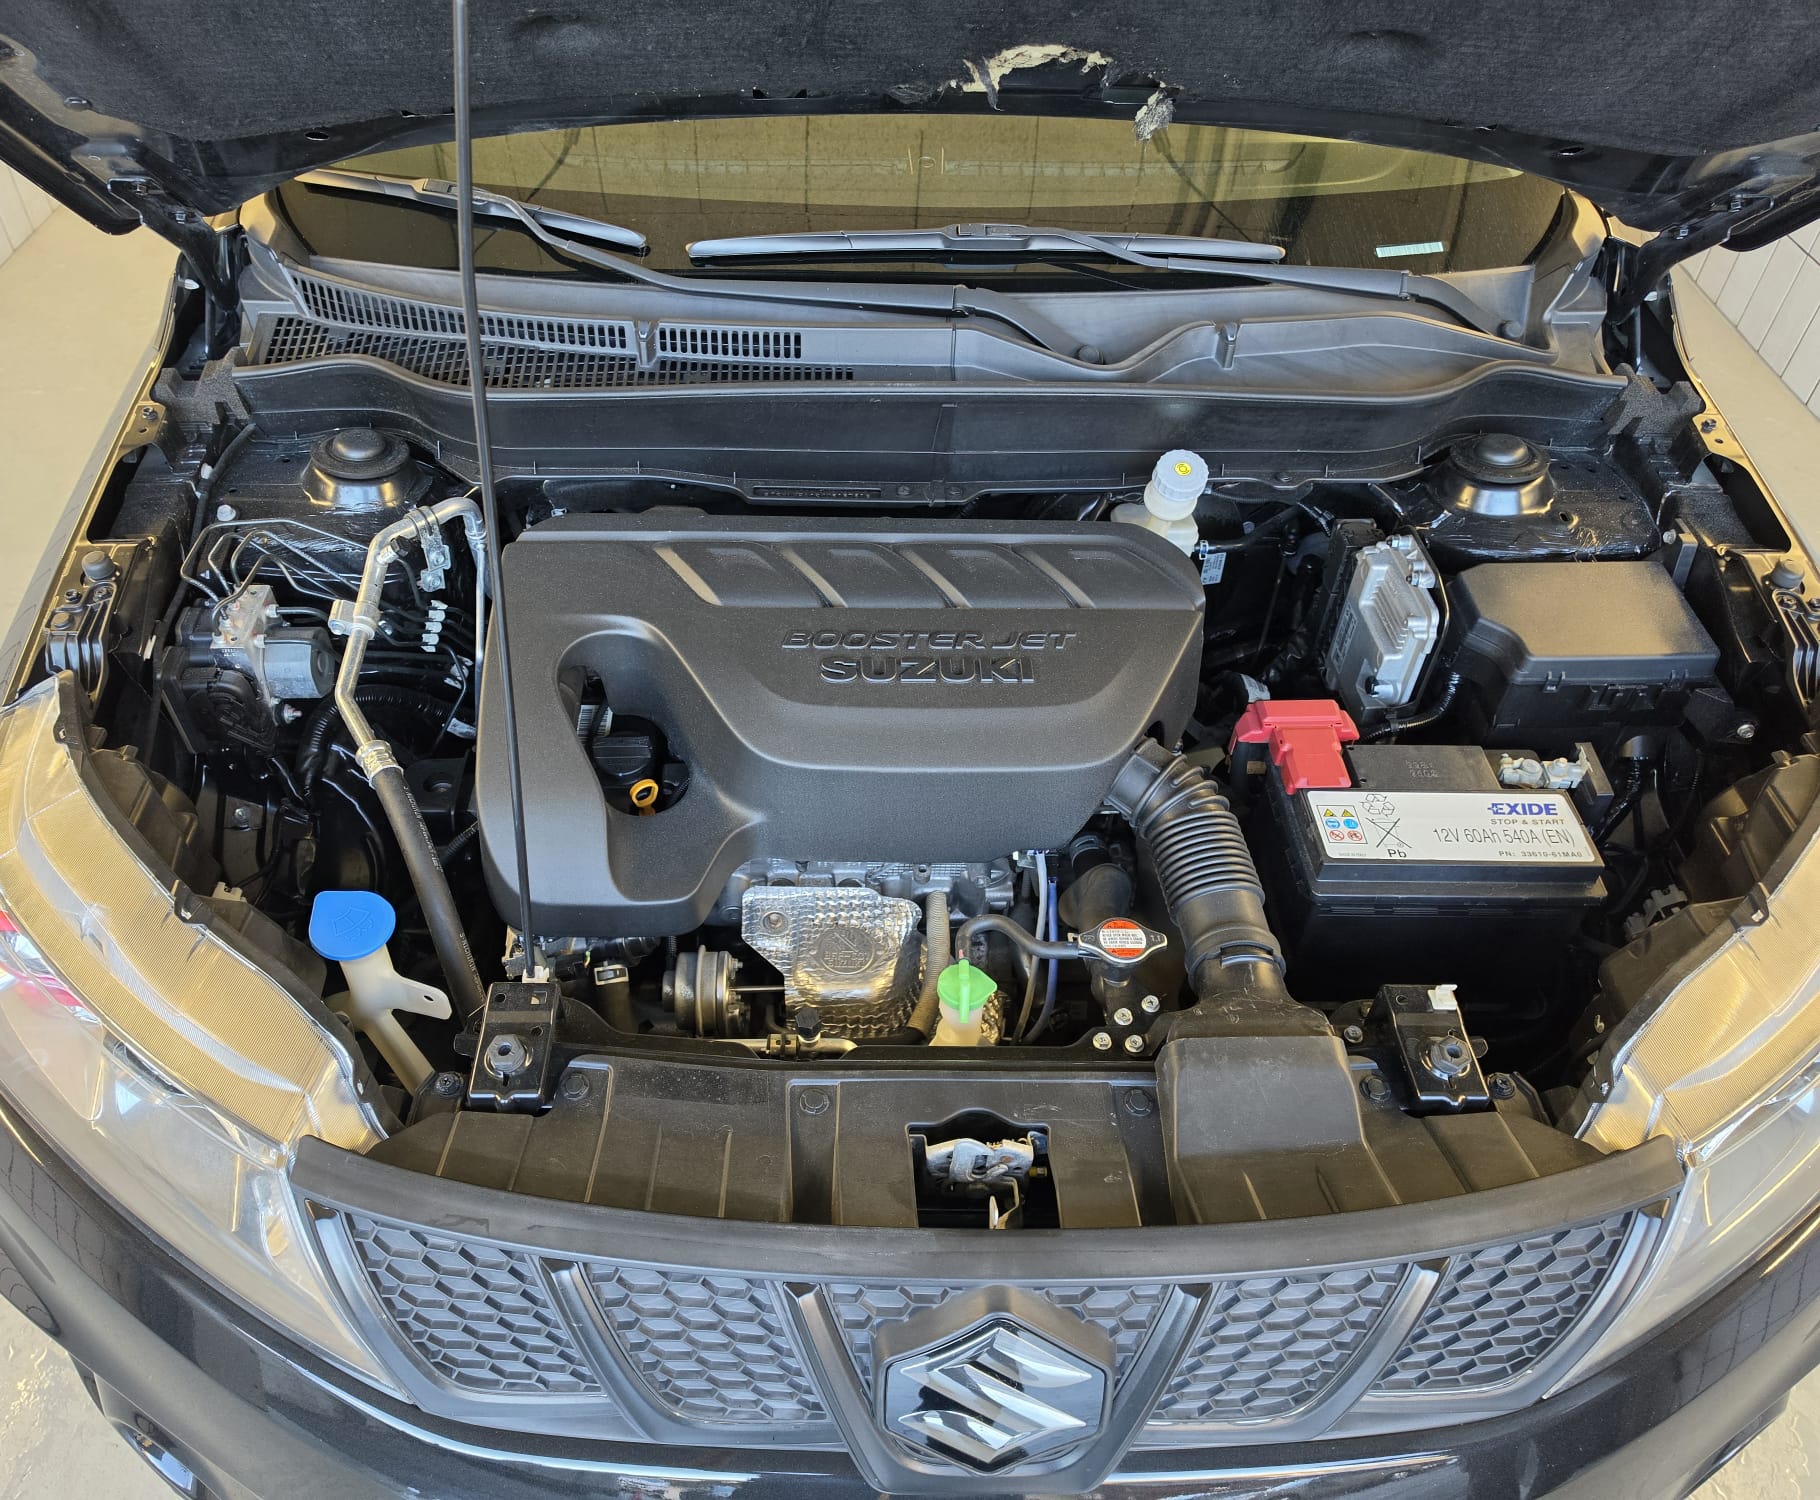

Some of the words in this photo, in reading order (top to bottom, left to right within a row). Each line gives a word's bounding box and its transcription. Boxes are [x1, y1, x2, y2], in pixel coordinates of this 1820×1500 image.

[820, 656, 1034, 683] SUZUKI
[1488, 803, 1558, 816] EXIDE
[1490, 818, 1518, 826] STOP
[1531, 818, 1566, 826] START
[1433, 828, 1459, 843] 12V
[1463, 828, 1501, 844] 60Ah
[1503, 829, 1541, 845] 540A
[1541, 829, 1576, 848] (EN)
[1387, 848, 1407, 858] Pb
